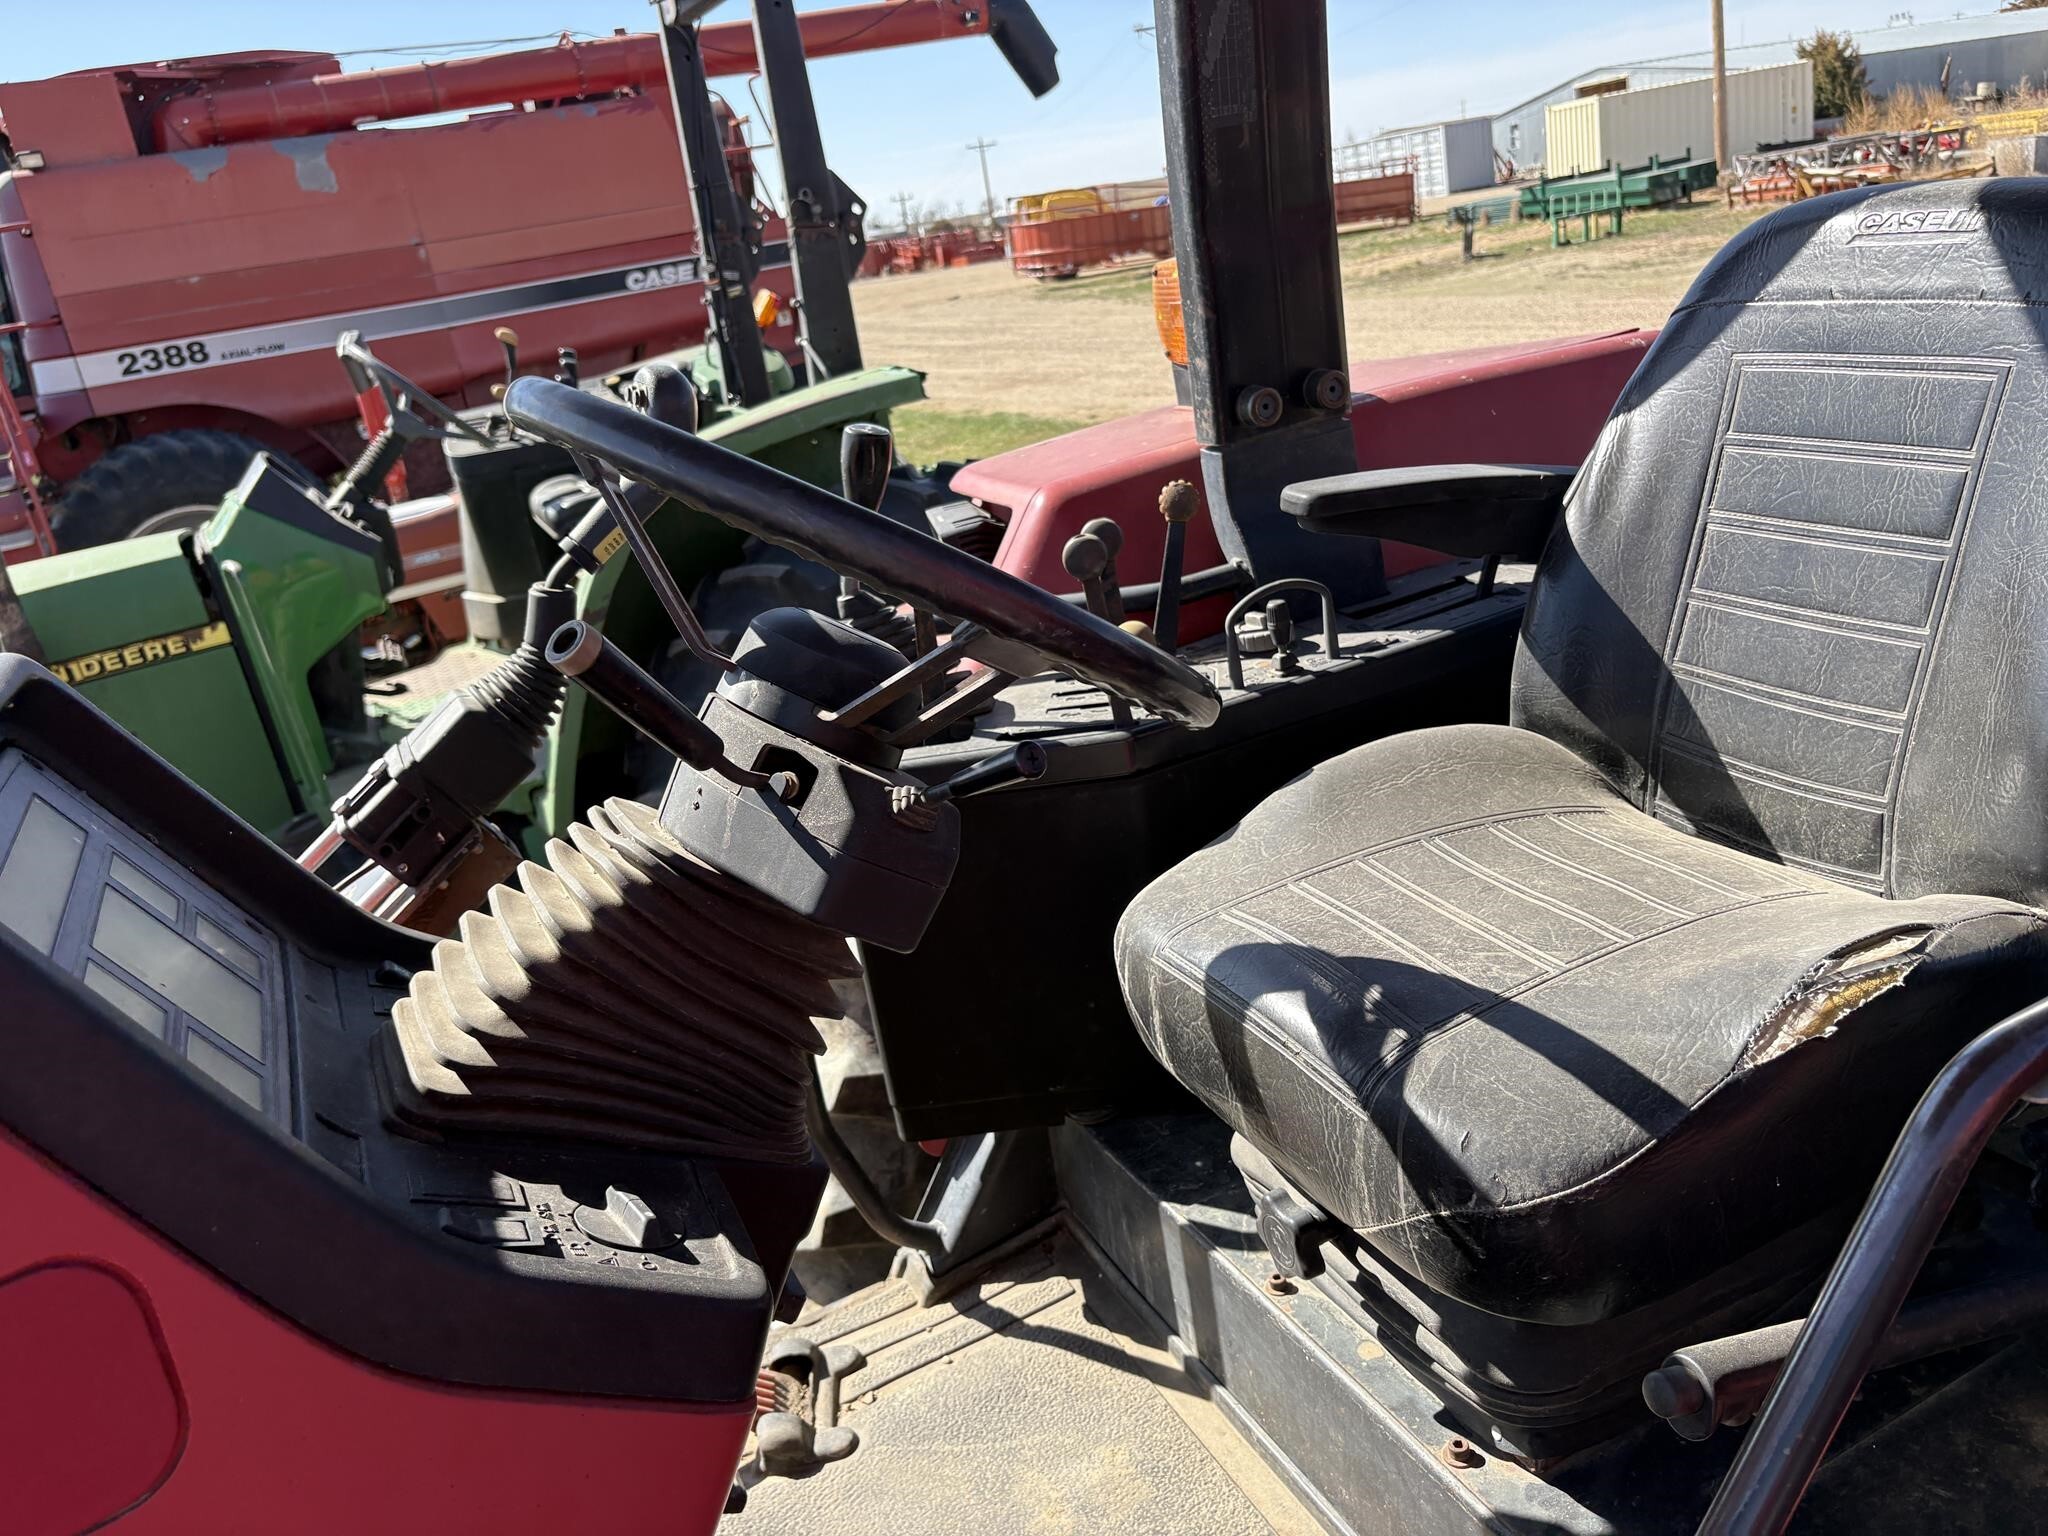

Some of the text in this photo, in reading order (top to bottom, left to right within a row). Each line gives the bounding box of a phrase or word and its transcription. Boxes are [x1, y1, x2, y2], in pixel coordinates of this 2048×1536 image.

[1857, 209, 1950, 233] CASE
[624, 262, 695, 291] CASE
[117, 341, 210, 377] 2388
